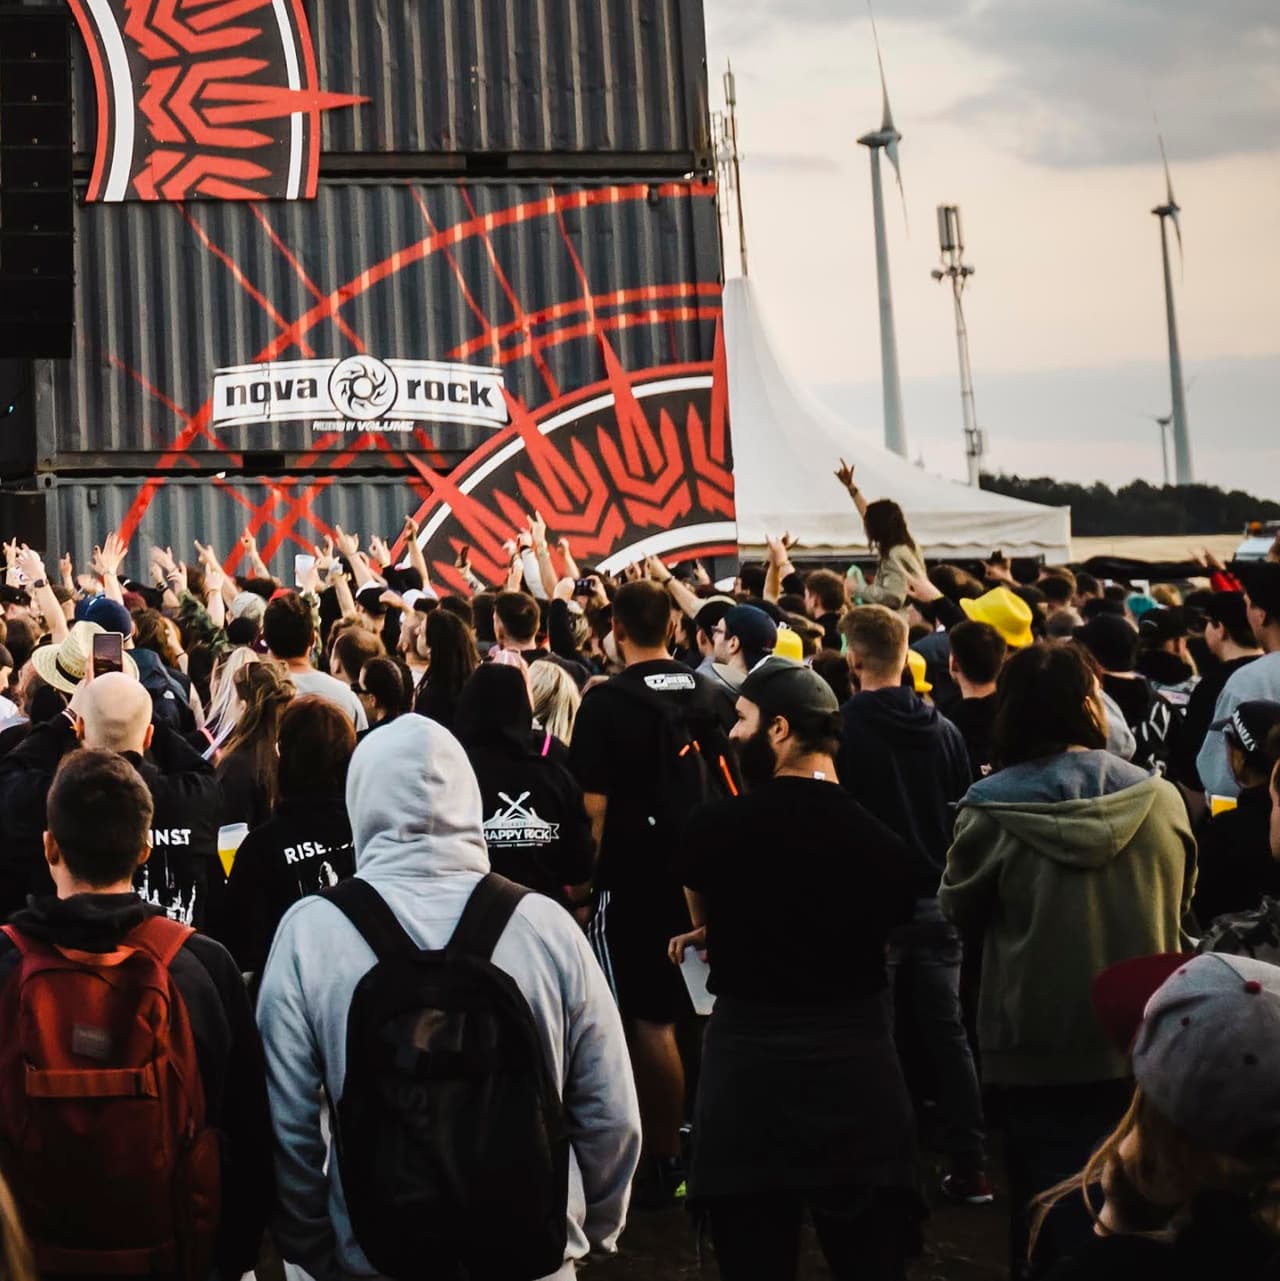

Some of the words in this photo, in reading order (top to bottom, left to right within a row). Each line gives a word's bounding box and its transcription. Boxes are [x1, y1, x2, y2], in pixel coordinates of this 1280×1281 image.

[225, 376, 318, 407] nova
[406, 376, 493, 408] rock
[357, 421, 415, 432] VOLUME
[148, 828, 192, 846] INST
[283, 841, 327, 865] RISE
